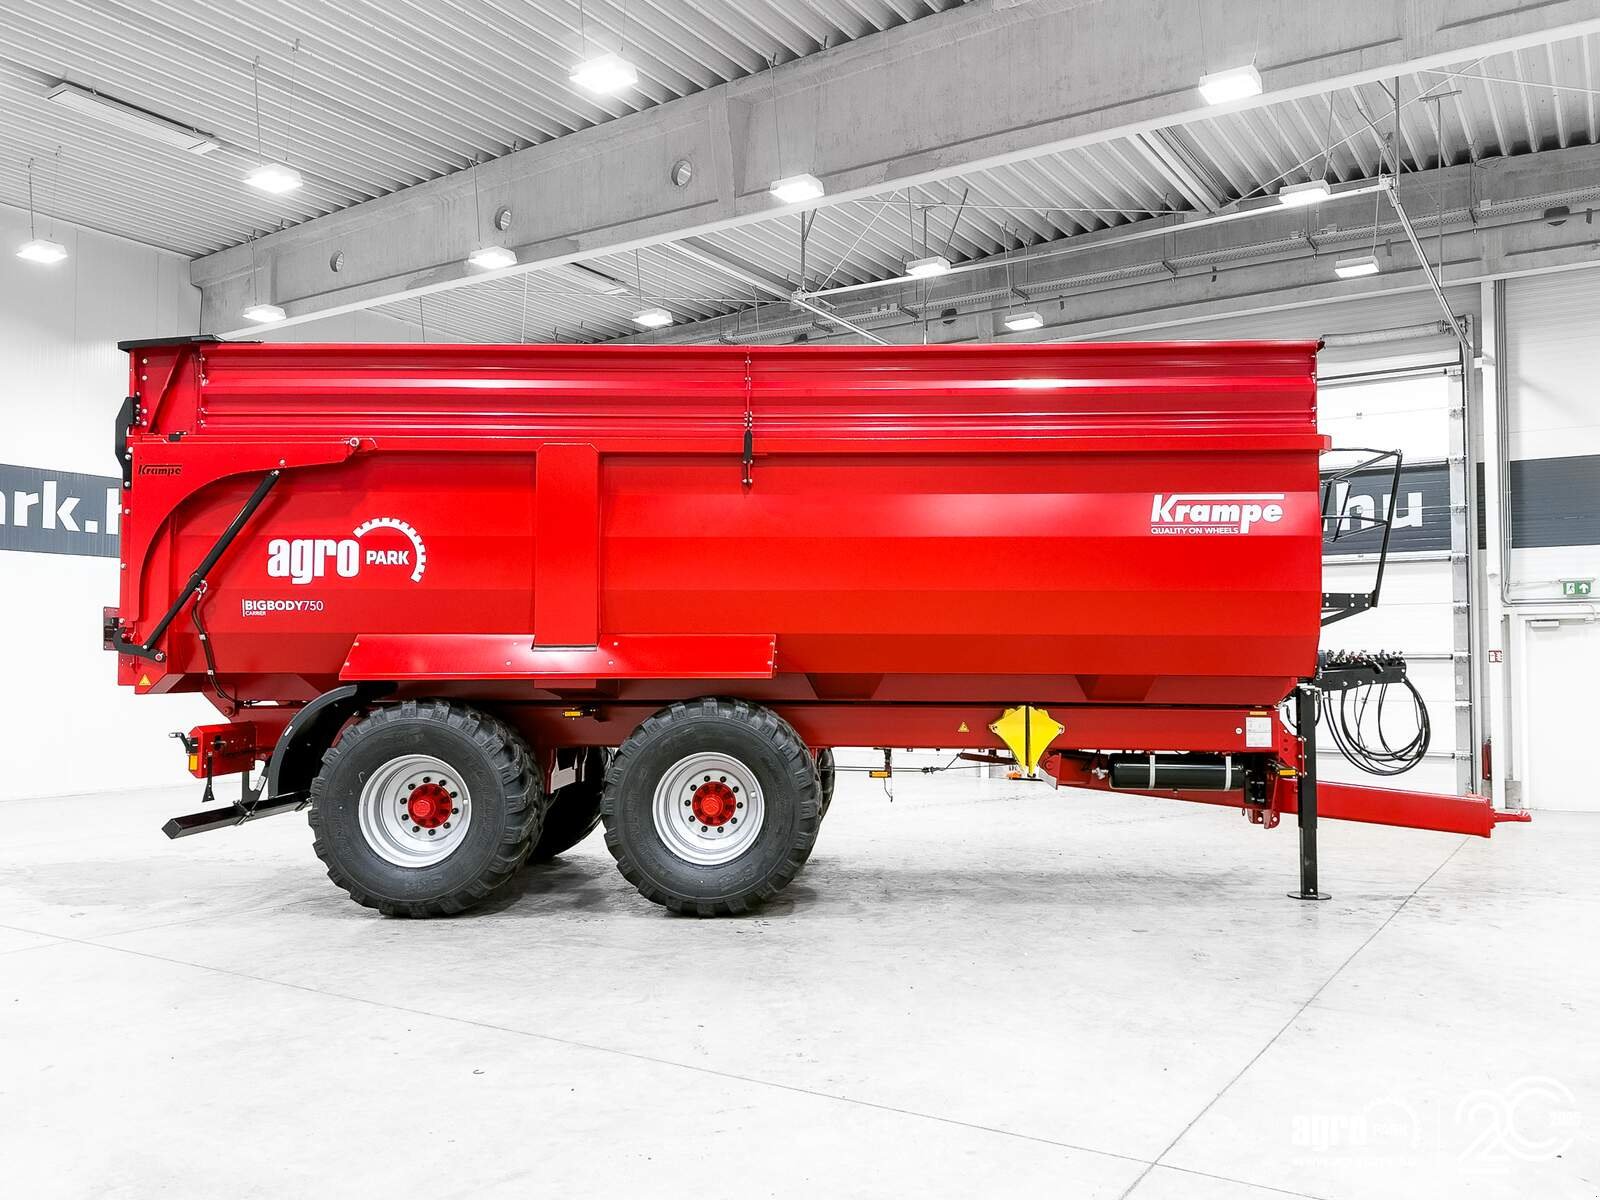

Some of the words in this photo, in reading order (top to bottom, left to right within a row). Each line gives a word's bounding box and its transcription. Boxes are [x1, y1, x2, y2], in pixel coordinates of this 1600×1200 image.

[138, 464, 182, 476] Krampe
[0, 480, 122, 535] rk.
[1151, 493, 1285, 534] Krampe
[1150, 527, 1187, 535] QUALITY
[1204, 527, 1239, 535] WHEELS
[267, 538, 360, 584] agro
[365, 550, 409, 565] PARK
